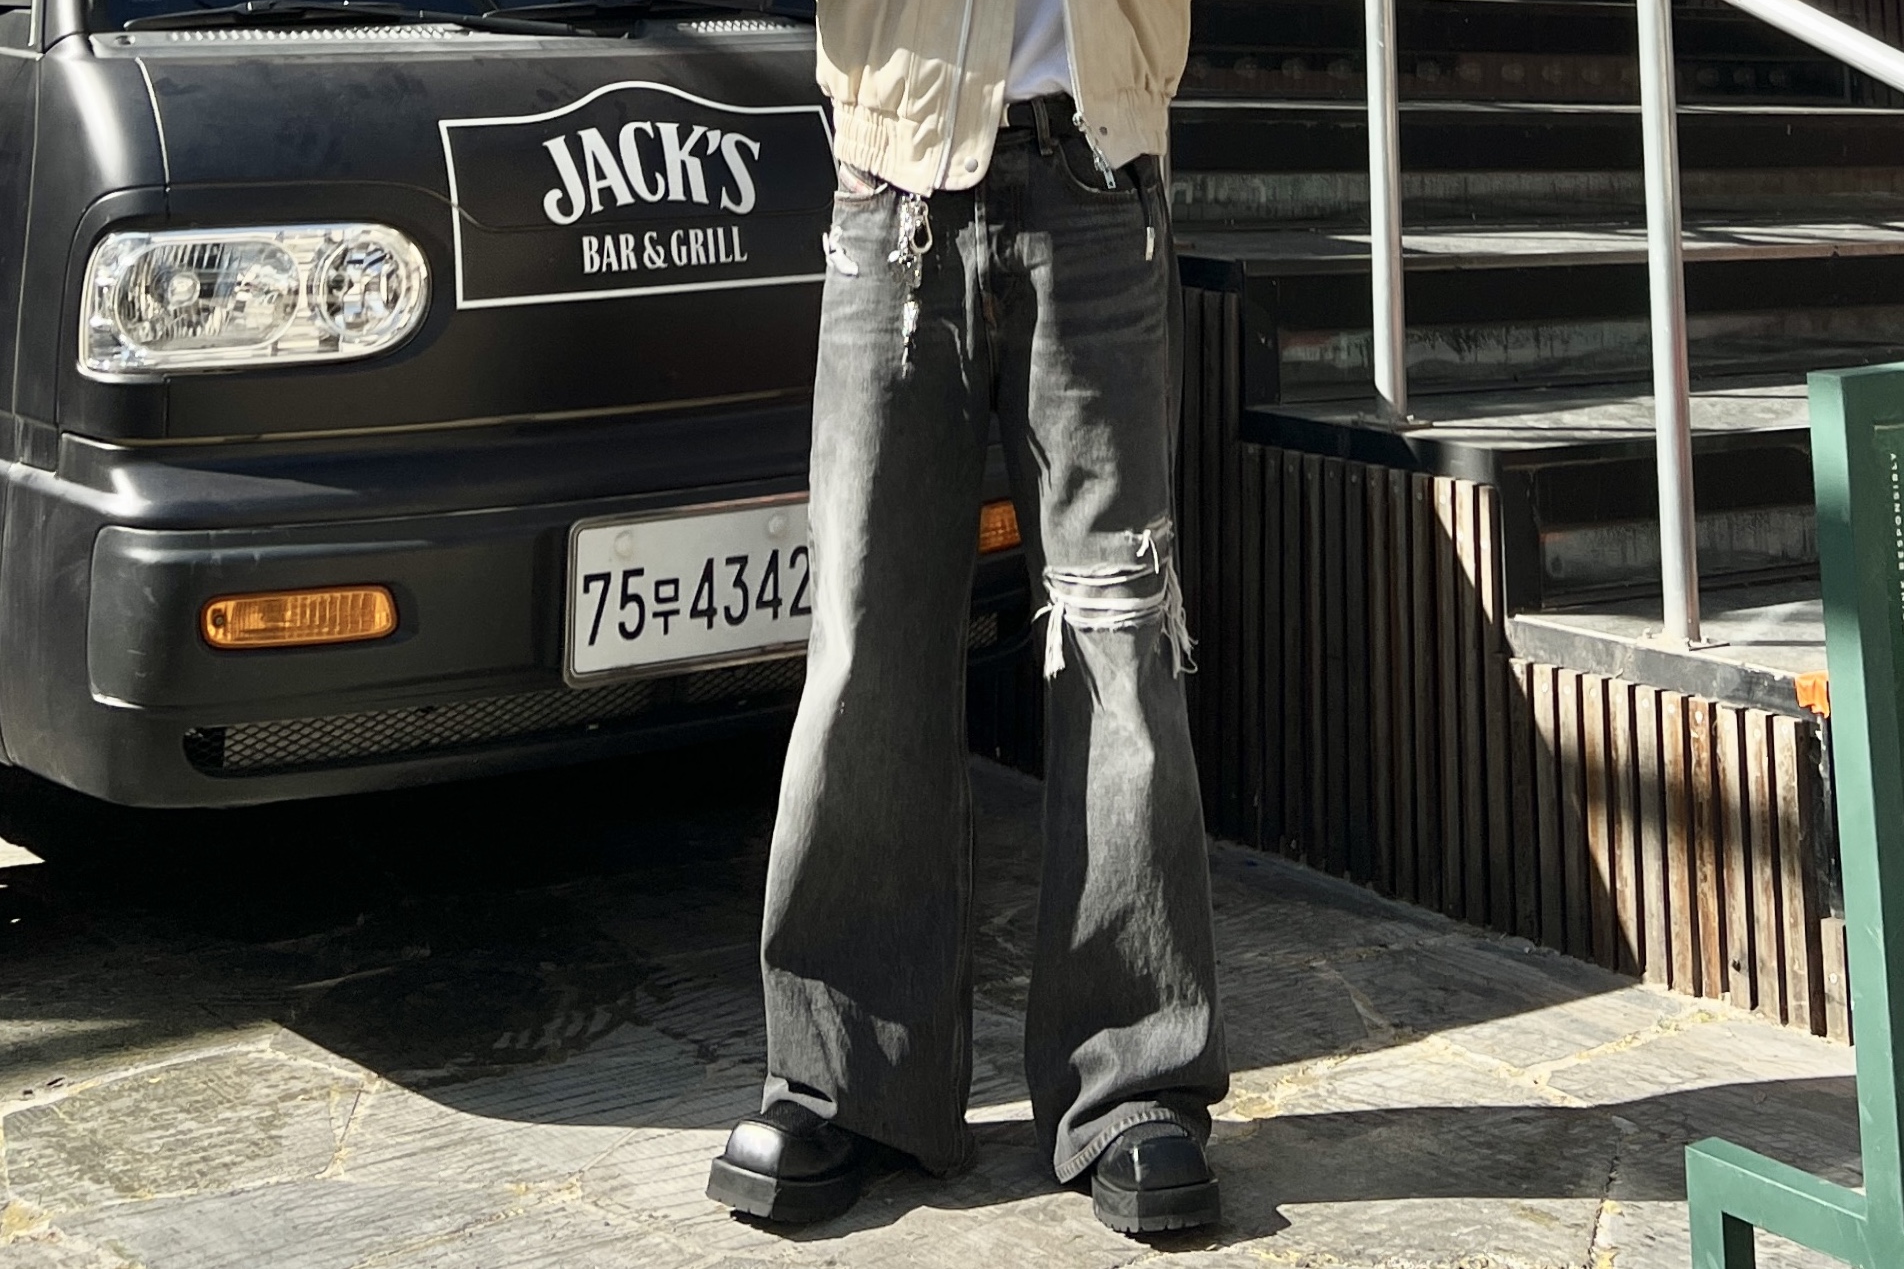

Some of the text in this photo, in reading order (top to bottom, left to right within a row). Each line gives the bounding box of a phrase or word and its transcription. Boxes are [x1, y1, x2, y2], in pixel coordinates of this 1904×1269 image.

[542, 121, 761, 225] JACK'S
[582, 226, 748, 274] BAR & GRILL
